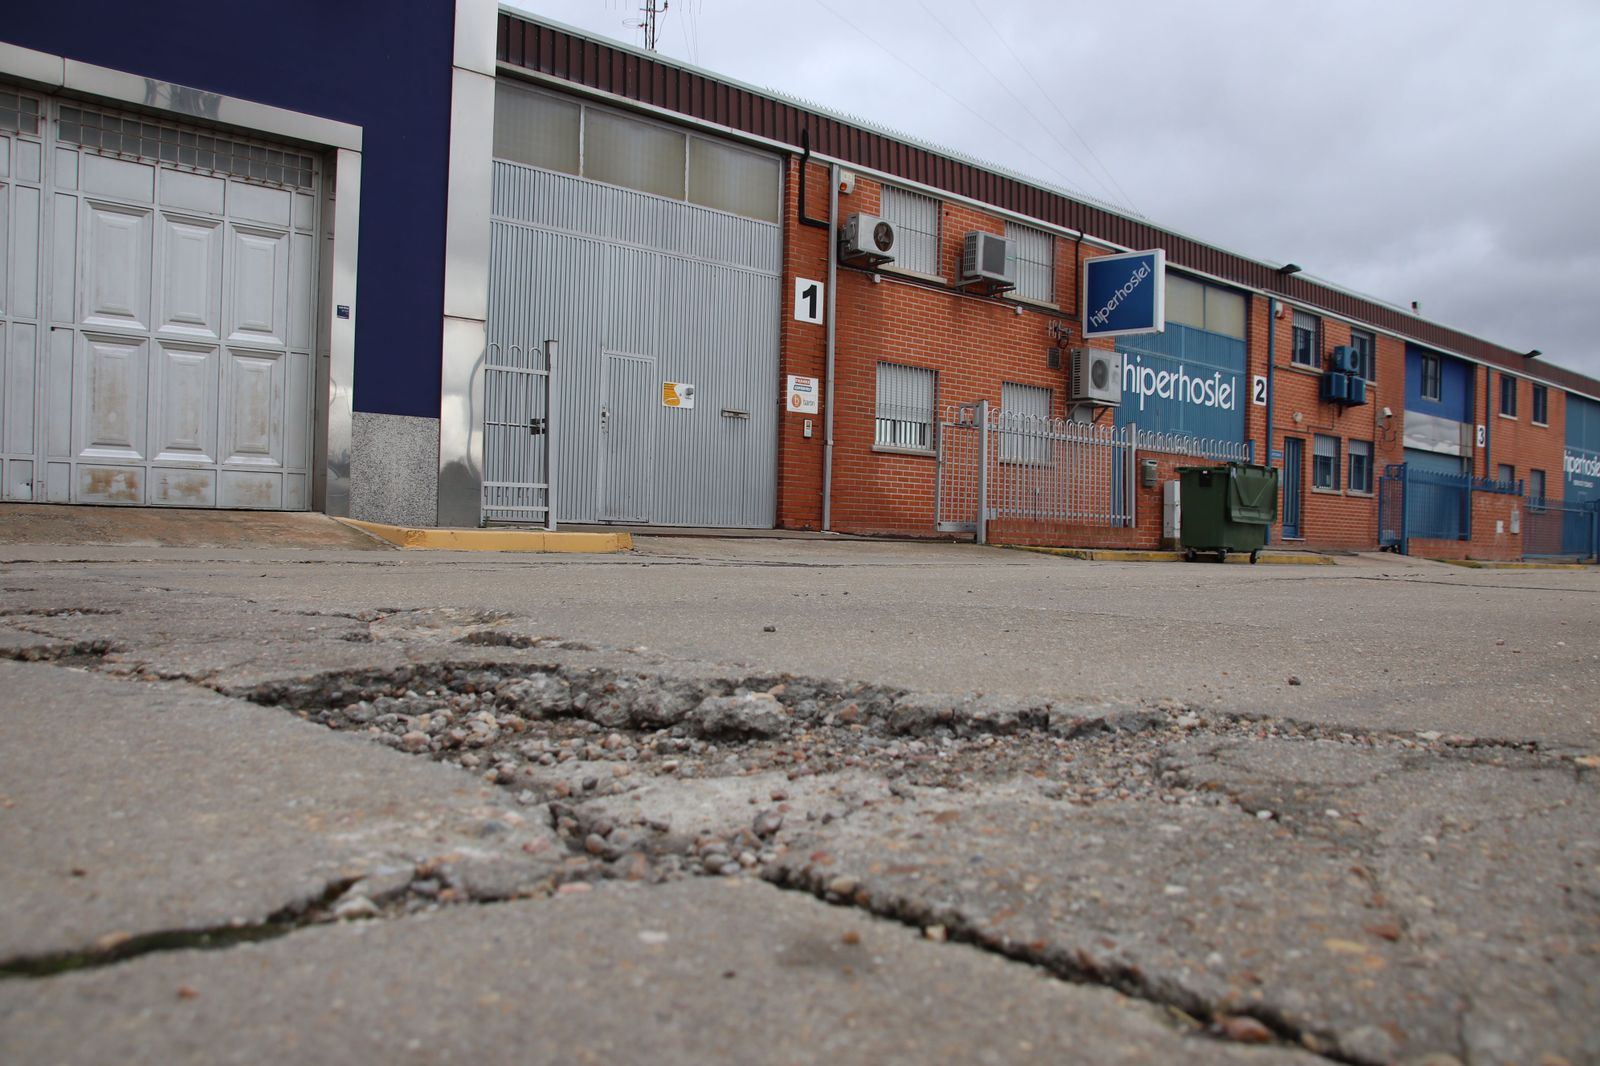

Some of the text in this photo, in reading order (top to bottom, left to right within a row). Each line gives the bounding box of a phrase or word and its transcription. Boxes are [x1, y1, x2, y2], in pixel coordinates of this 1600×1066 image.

[802, 284, 817, 319] 1
[1089, 261, 1151, 327] hiperhostel
[1122, 353, 1236, 411] hiperhostel
[1255, 379, 1266, 403] 2
[1479, 427, 1485, 445] 3
